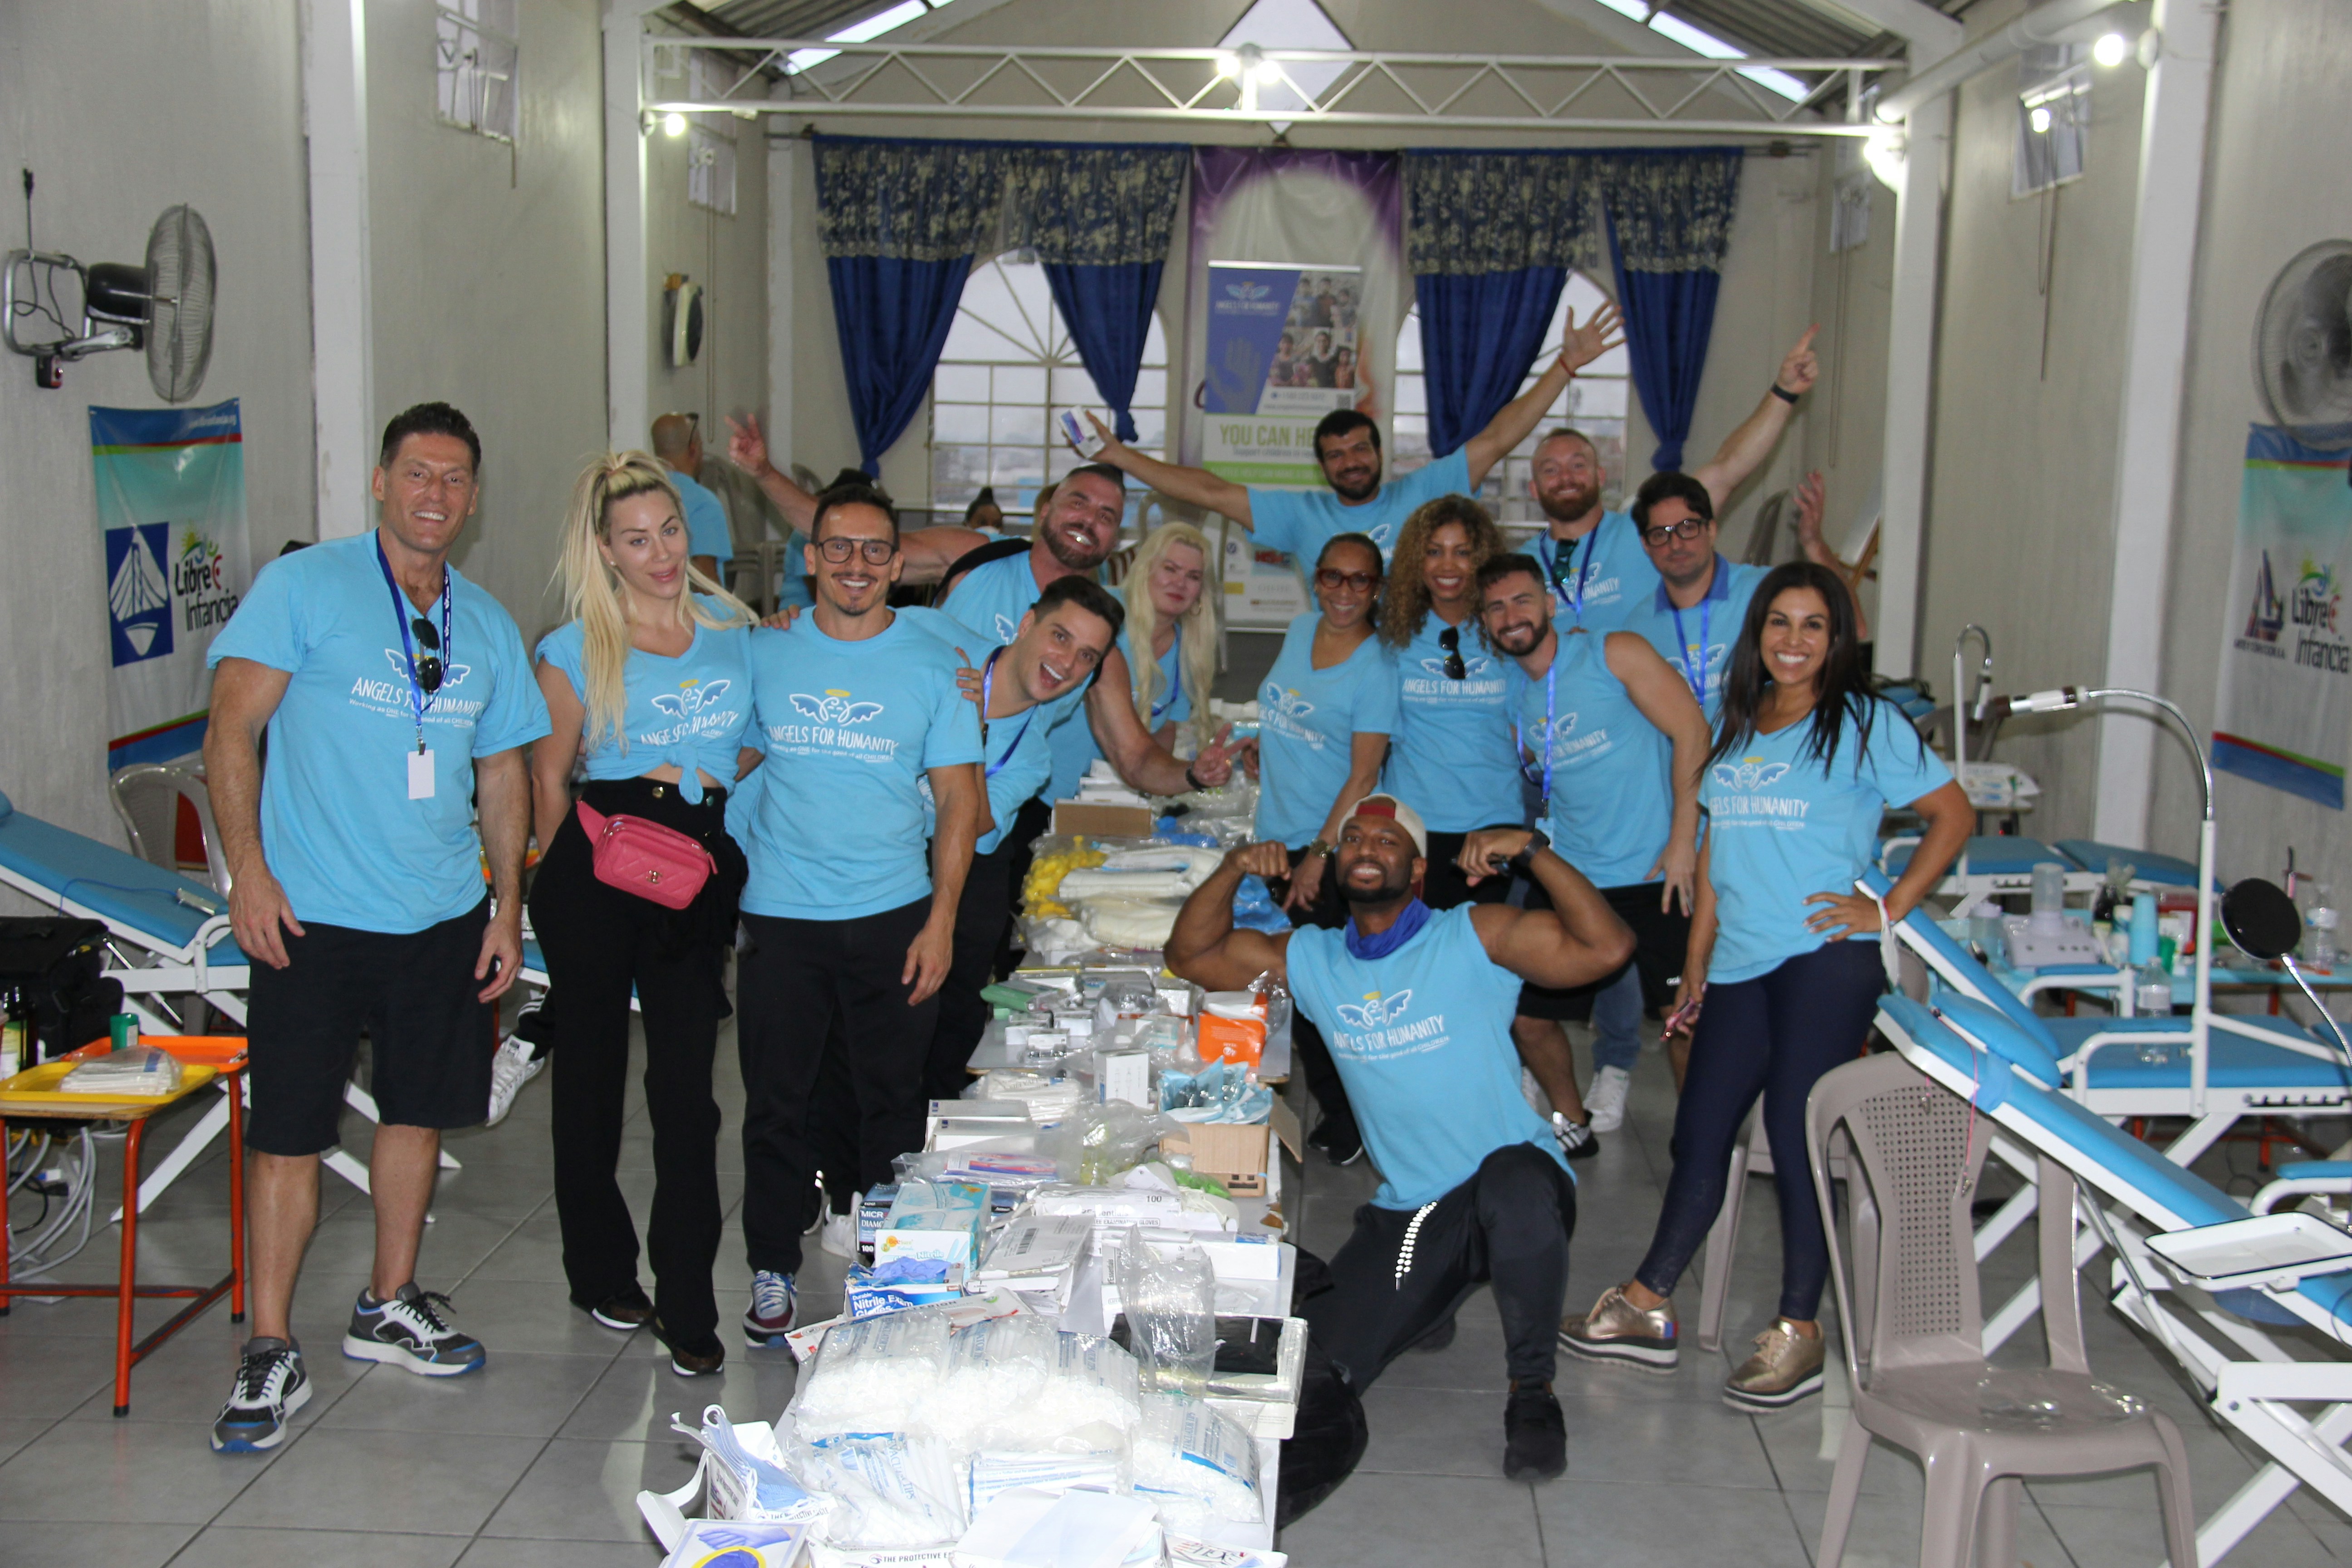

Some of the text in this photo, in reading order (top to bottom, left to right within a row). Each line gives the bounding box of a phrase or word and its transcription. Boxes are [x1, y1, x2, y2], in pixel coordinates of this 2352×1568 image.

[1220, 423, 1316, 447] YOU CAN HE
[174, 558, 211, 596] Libre
[2292, 588, 2328, 628] Libre
[2294, 628, 2349, 674] Infancia
[351, 676, 403, 704] ANGELS
[1402, 678, 1438, 694] ANGELS
[1441, 680, 1460, 695] FOR
[349, 698, 376, 711] Working
[768, 725, 899, 755] ANGELS FOR HUMANITY
[1731, 795, 1749, 815] FOR
[1750, 795, 1810, 818] HUMANITY
[1364, 1031, 1387, 1051] FOR
[1387, 1014, 1445, 1047] HUMANITY
[916, 1250, 944, 1259] Nitrile
[853, 1292, 873, 1301] Durable
[853, 1294, 913, 1311] Nitrile Exam
[899, 1552, 941, 1562] PROTECTIVE
